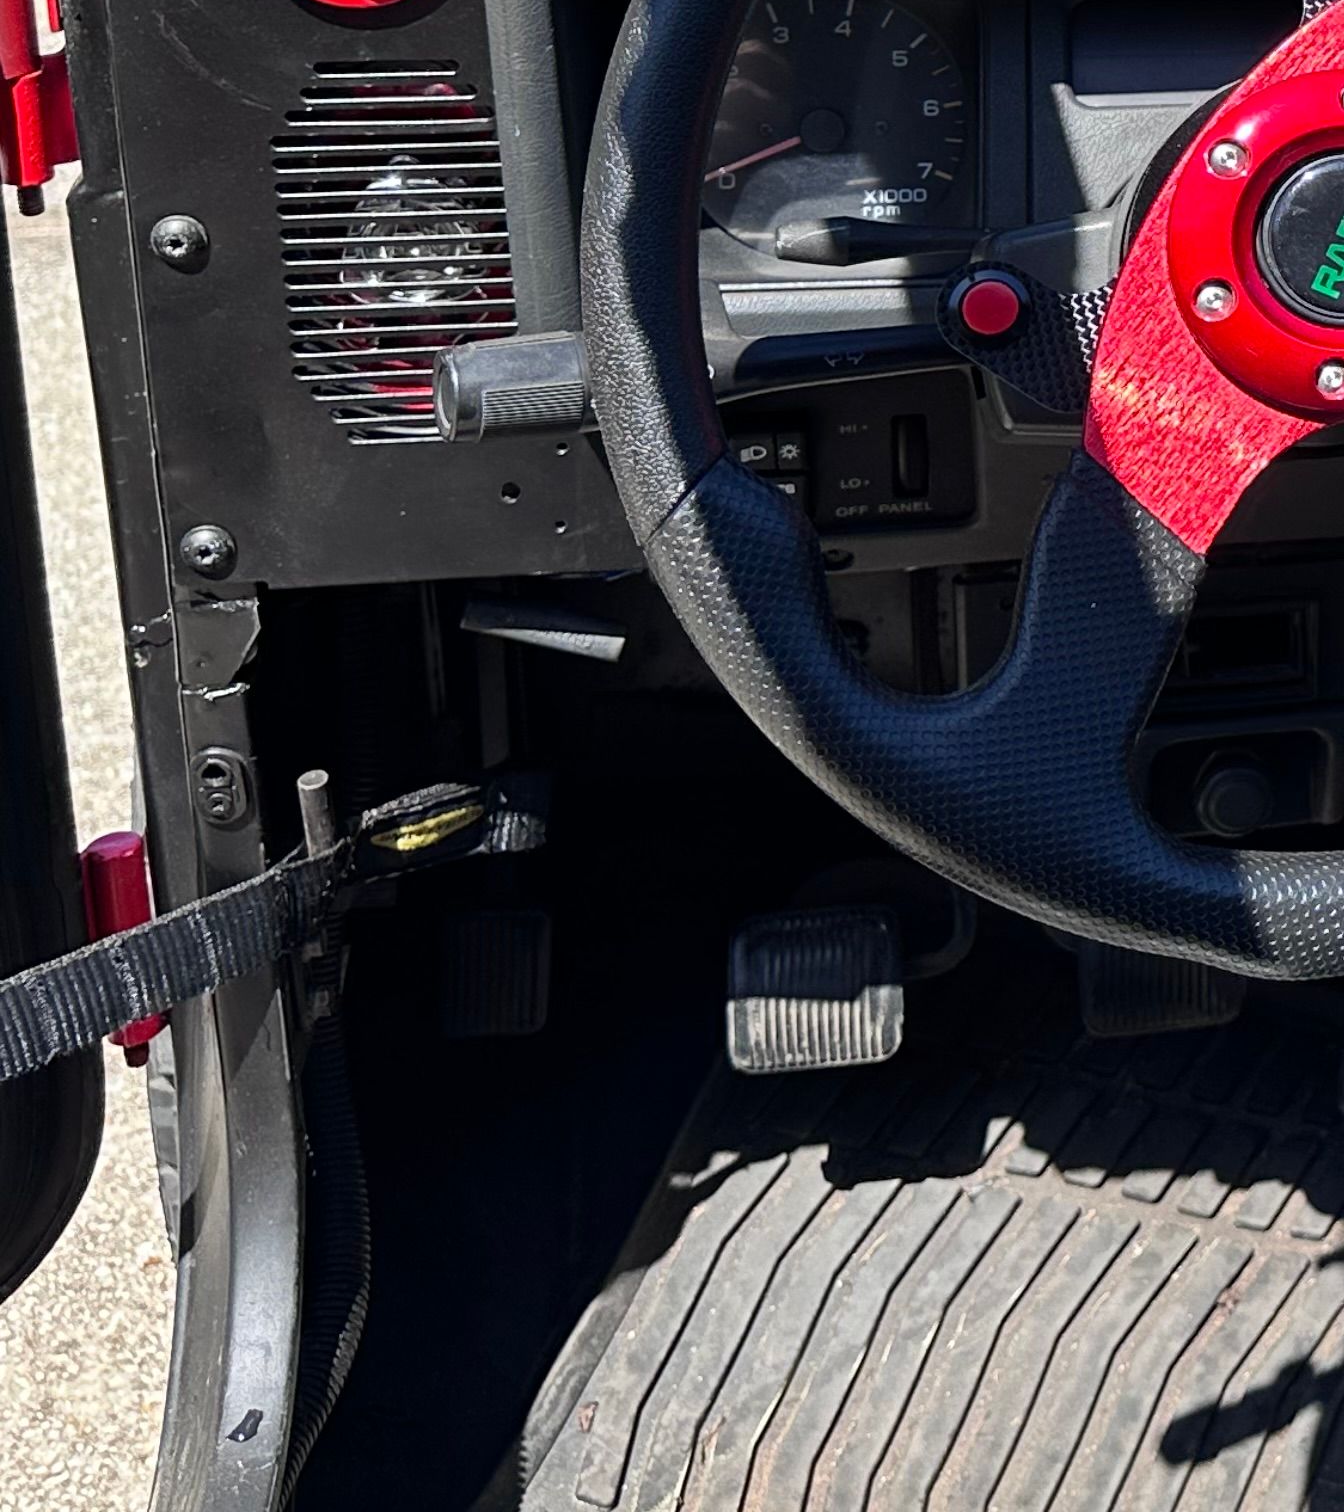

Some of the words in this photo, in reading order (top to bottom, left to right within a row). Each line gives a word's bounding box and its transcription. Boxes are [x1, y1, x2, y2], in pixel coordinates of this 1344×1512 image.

[772, 26, 790, 43] 3
[834, 20, 851, 37] 4
[891, 51, 909, 67] 5
[922, 99, 940, 116] 6
[917, 162, 934, 178] 7
[862, 204, 901, 218] rpm
[835, 504, 868, 518] OFF
[878, 500, 933, 514] PANEL
